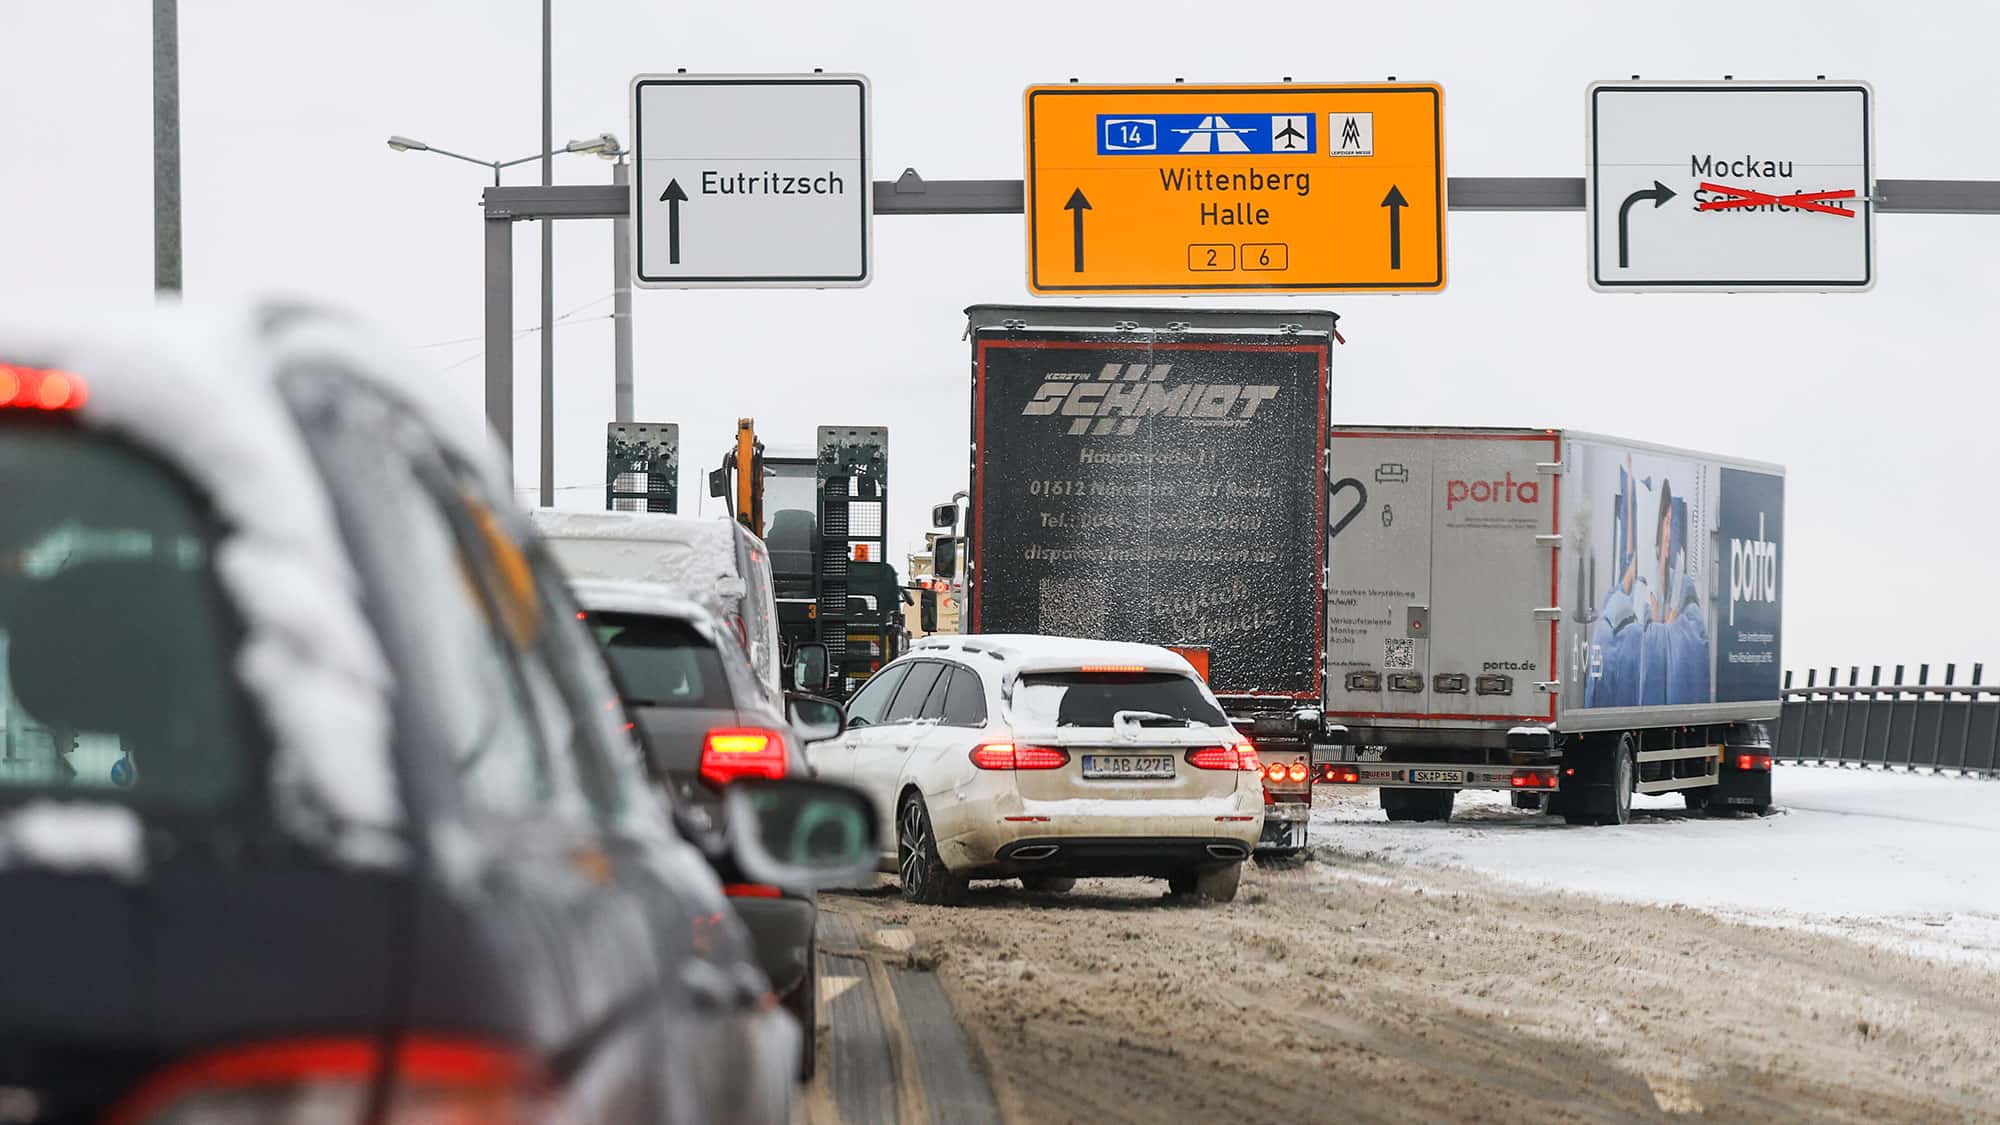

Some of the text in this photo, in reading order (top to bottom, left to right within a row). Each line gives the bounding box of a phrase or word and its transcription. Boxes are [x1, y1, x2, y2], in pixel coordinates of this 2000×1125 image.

[1119, 125, 1142, 145] 14
[1691, 154, 1793, 178] Mockau
[701, 171, 845, 195] Eutritzsch
[1160, 167, 1310, 196] Wittenberg
[1200, 203, 1270, 226] Halle
[1205, 249, 1270, 267] 2 6
[1022, 383, 1280, 417] SCHMIDT
[1029, 479, 1085, 496] 01612
[1446, 471, 1539, 511] porta
[1729, 511, 1777, 627] porta
[1482, 660, 1537, 672] porta.de
